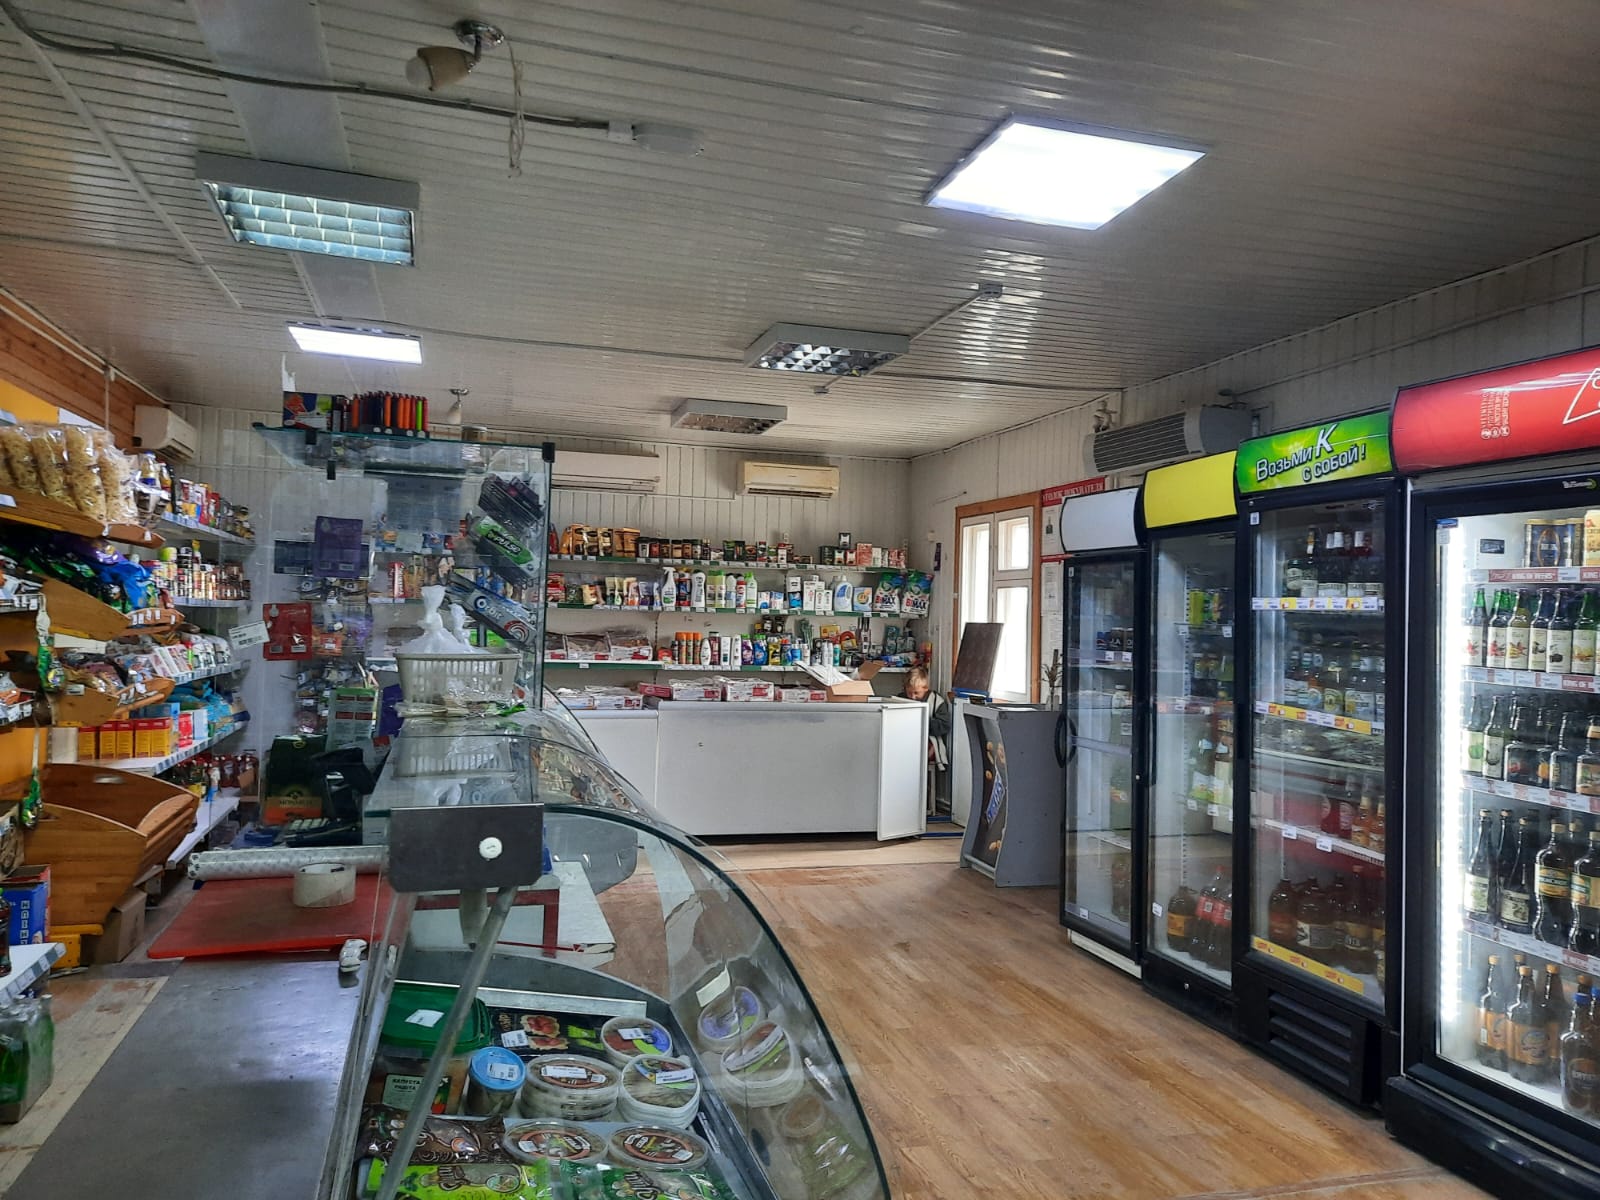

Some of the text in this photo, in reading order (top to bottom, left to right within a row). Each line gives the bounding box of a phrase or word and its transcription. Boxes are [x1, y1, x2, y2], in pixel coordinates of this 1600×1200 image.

[1255, 423, 1338, 482] Возьми К
[475, 597, 504, 620] Orbit
